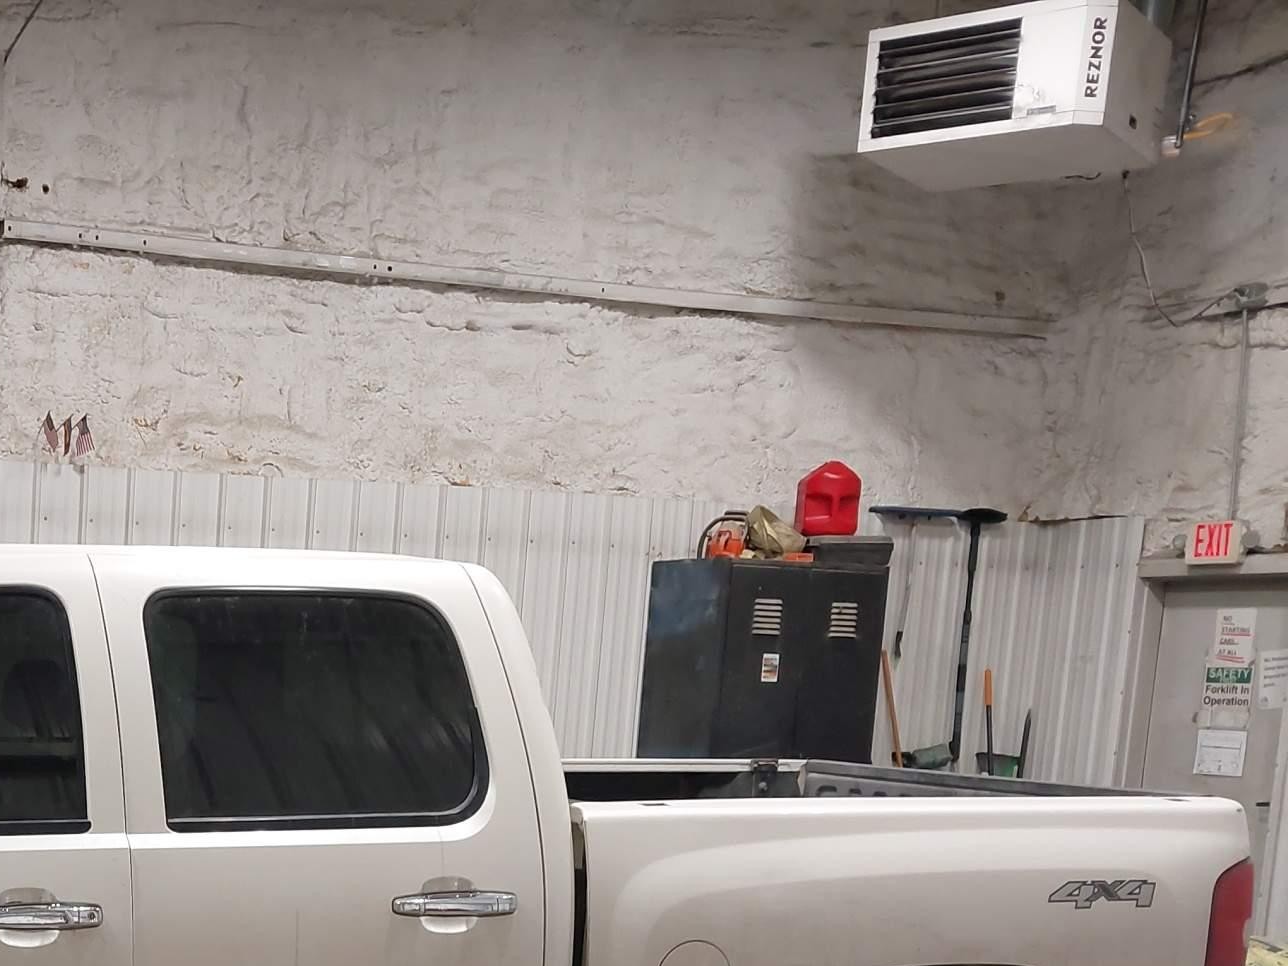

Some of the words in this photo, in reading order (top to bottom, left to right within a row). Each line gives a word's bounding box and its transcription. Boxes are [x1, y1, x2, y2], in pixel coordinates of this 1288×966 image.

[1084, 16, 1108, 98] REZNOR
[1194, 522, 1233, 557] EXIT
[1208, 667, 1250, 680] SAFETY
[1205, 684, 1239, 695] Forklift
[1240, 685, 1250, 695] In
[1203, 695, 1249, 707] Operation
